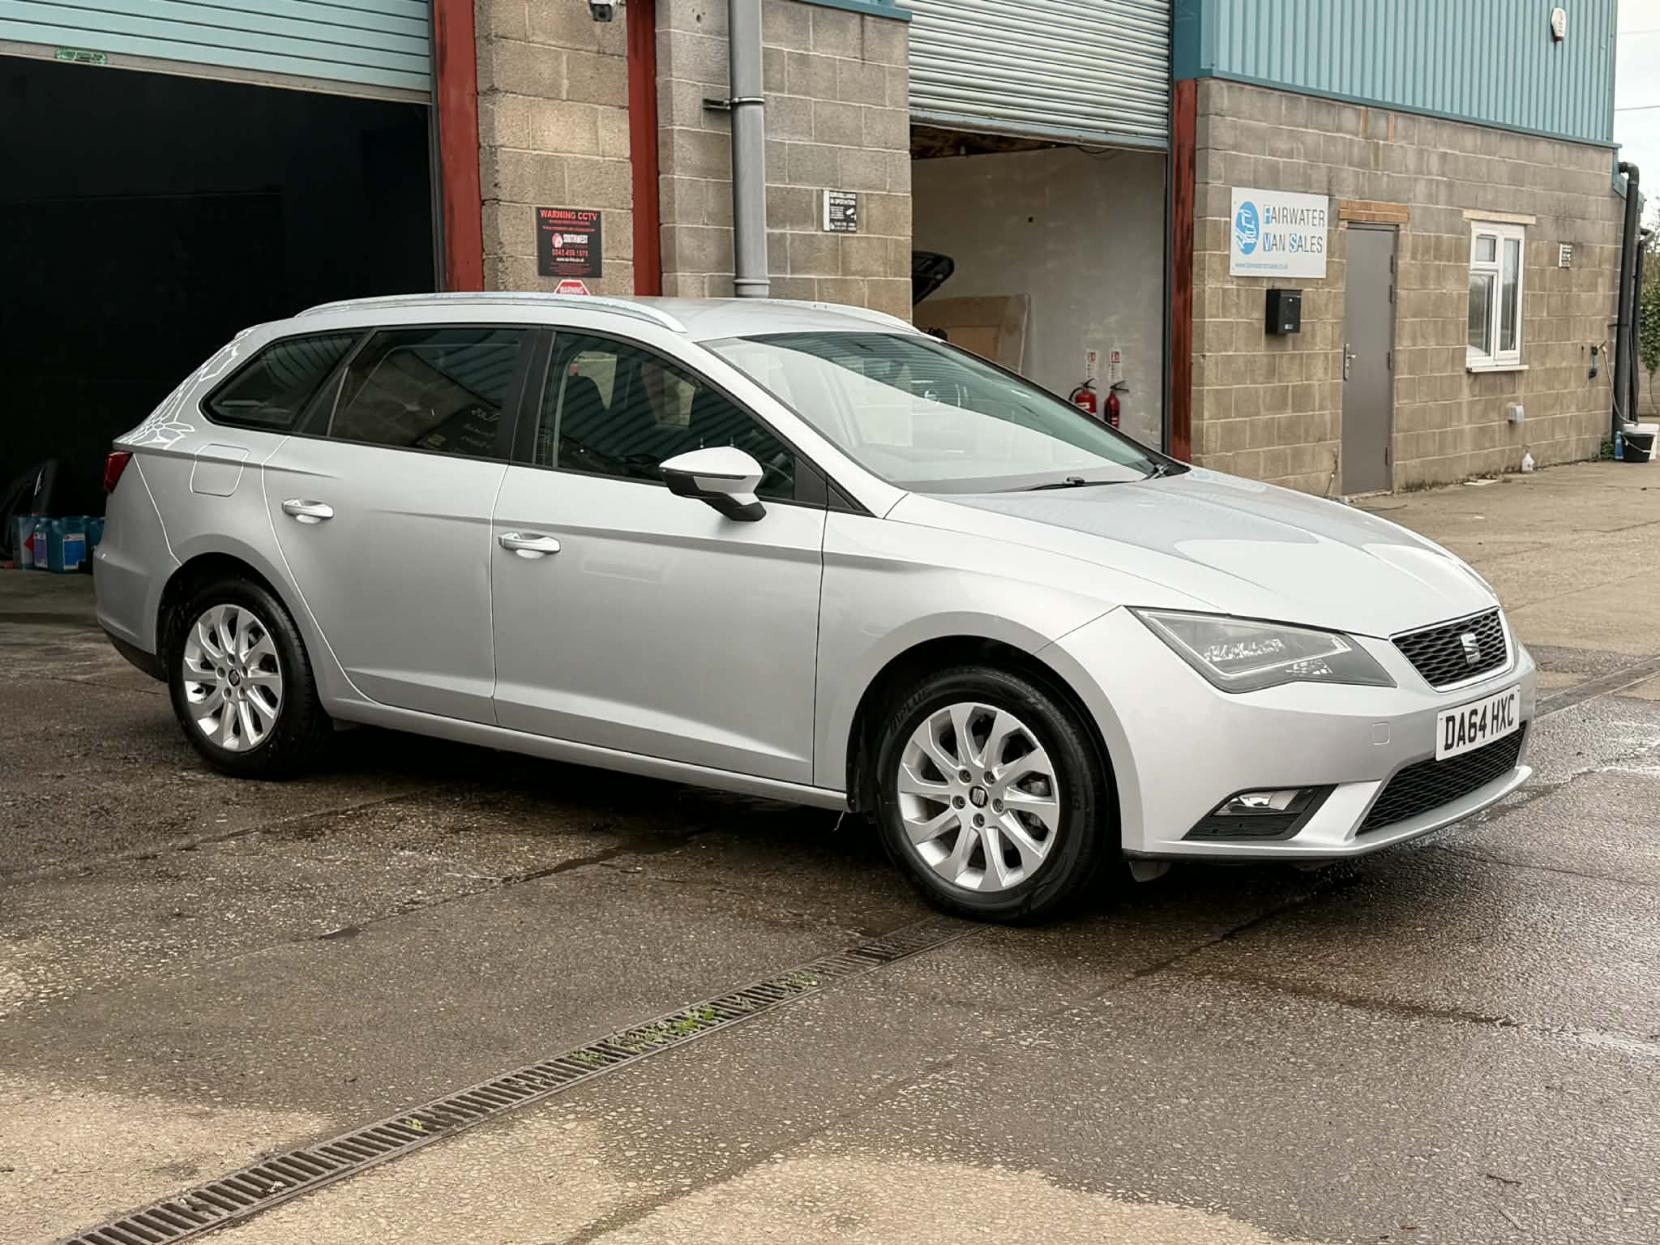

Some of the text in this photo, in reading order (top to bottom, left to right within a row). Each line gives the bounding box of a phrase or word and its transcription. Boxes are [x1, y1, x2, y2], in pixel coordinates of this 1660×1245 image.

[540, 209, 598, 221] WARNING CCTV
[1263, 204, 1325, 228] FAIRWATER
[1263, 232, 1323, 254] VAN SALES
[1444, 694, 1515, 751] DA64 HXC
